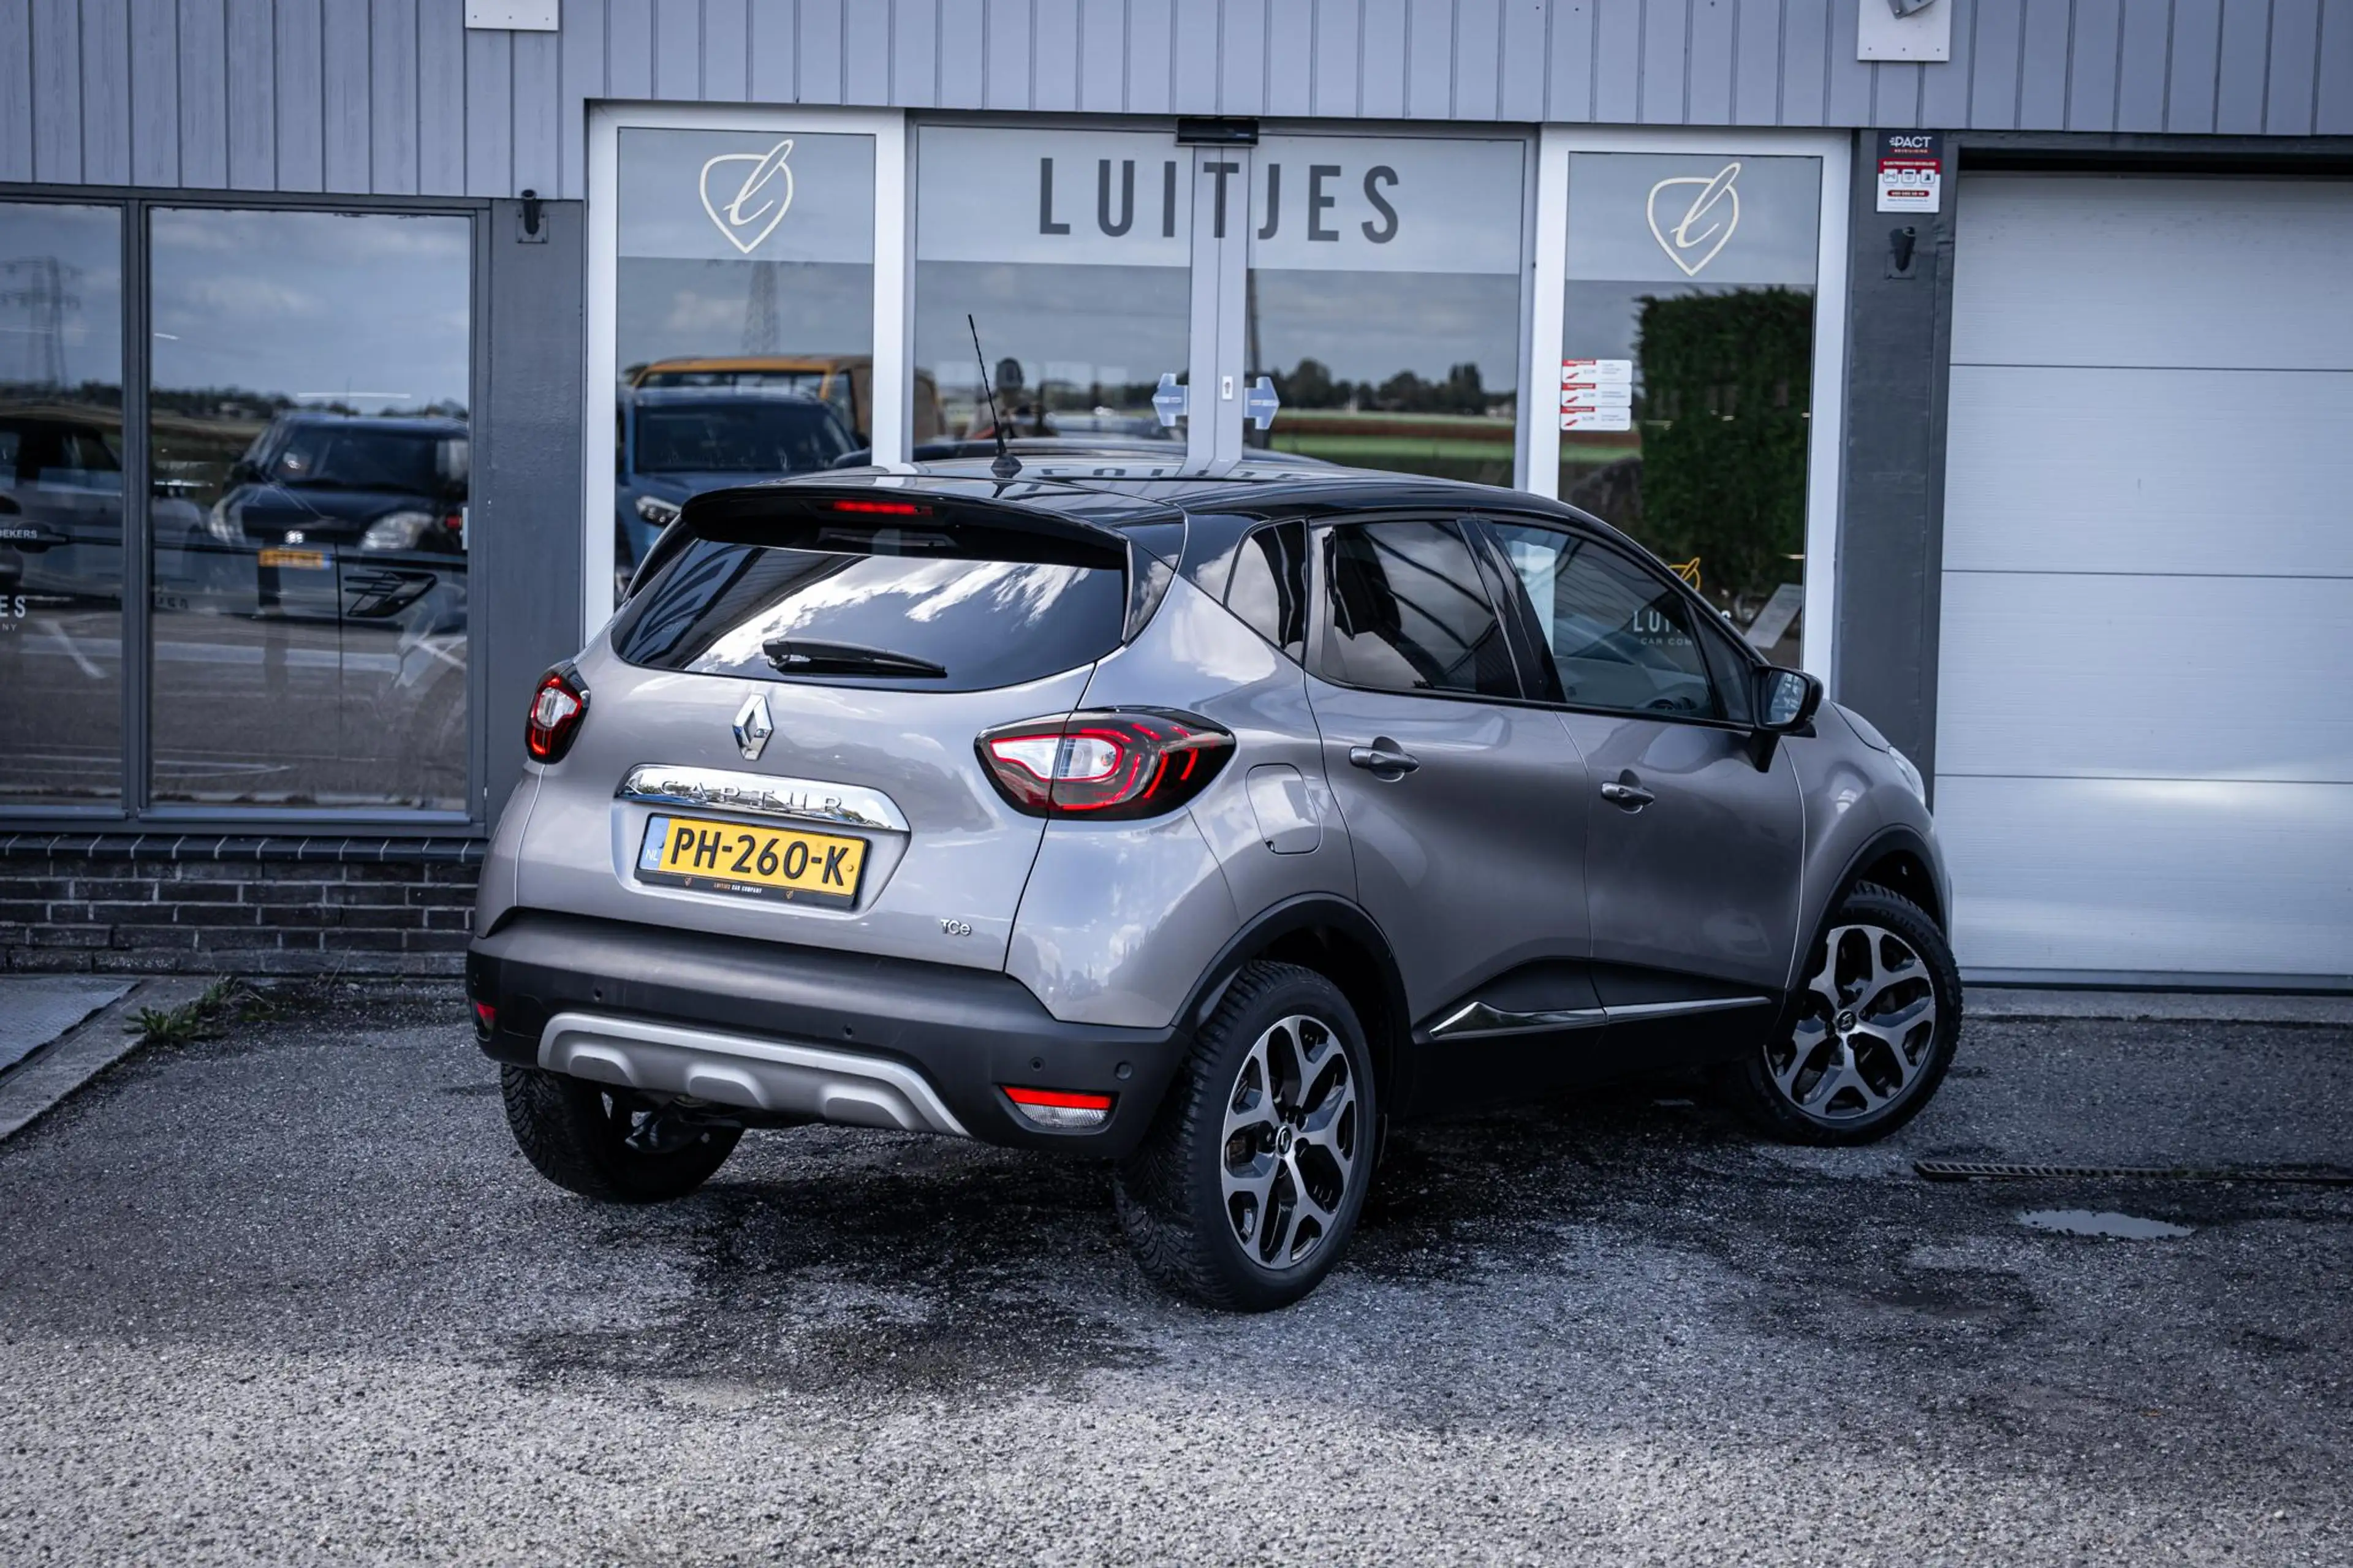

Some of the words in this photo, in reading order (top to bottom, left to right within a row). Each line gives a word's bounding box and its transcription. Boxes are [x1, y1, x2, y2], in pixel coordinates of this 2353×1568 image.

[1039, 157, 1399, 244] LUITJES
[661, 779, 843, 813] CAPTUR
[645, 848, 657, 862] NL
[670, 827, 849, 887] PH-260-K
[940, 918, 972, 937] TCe
